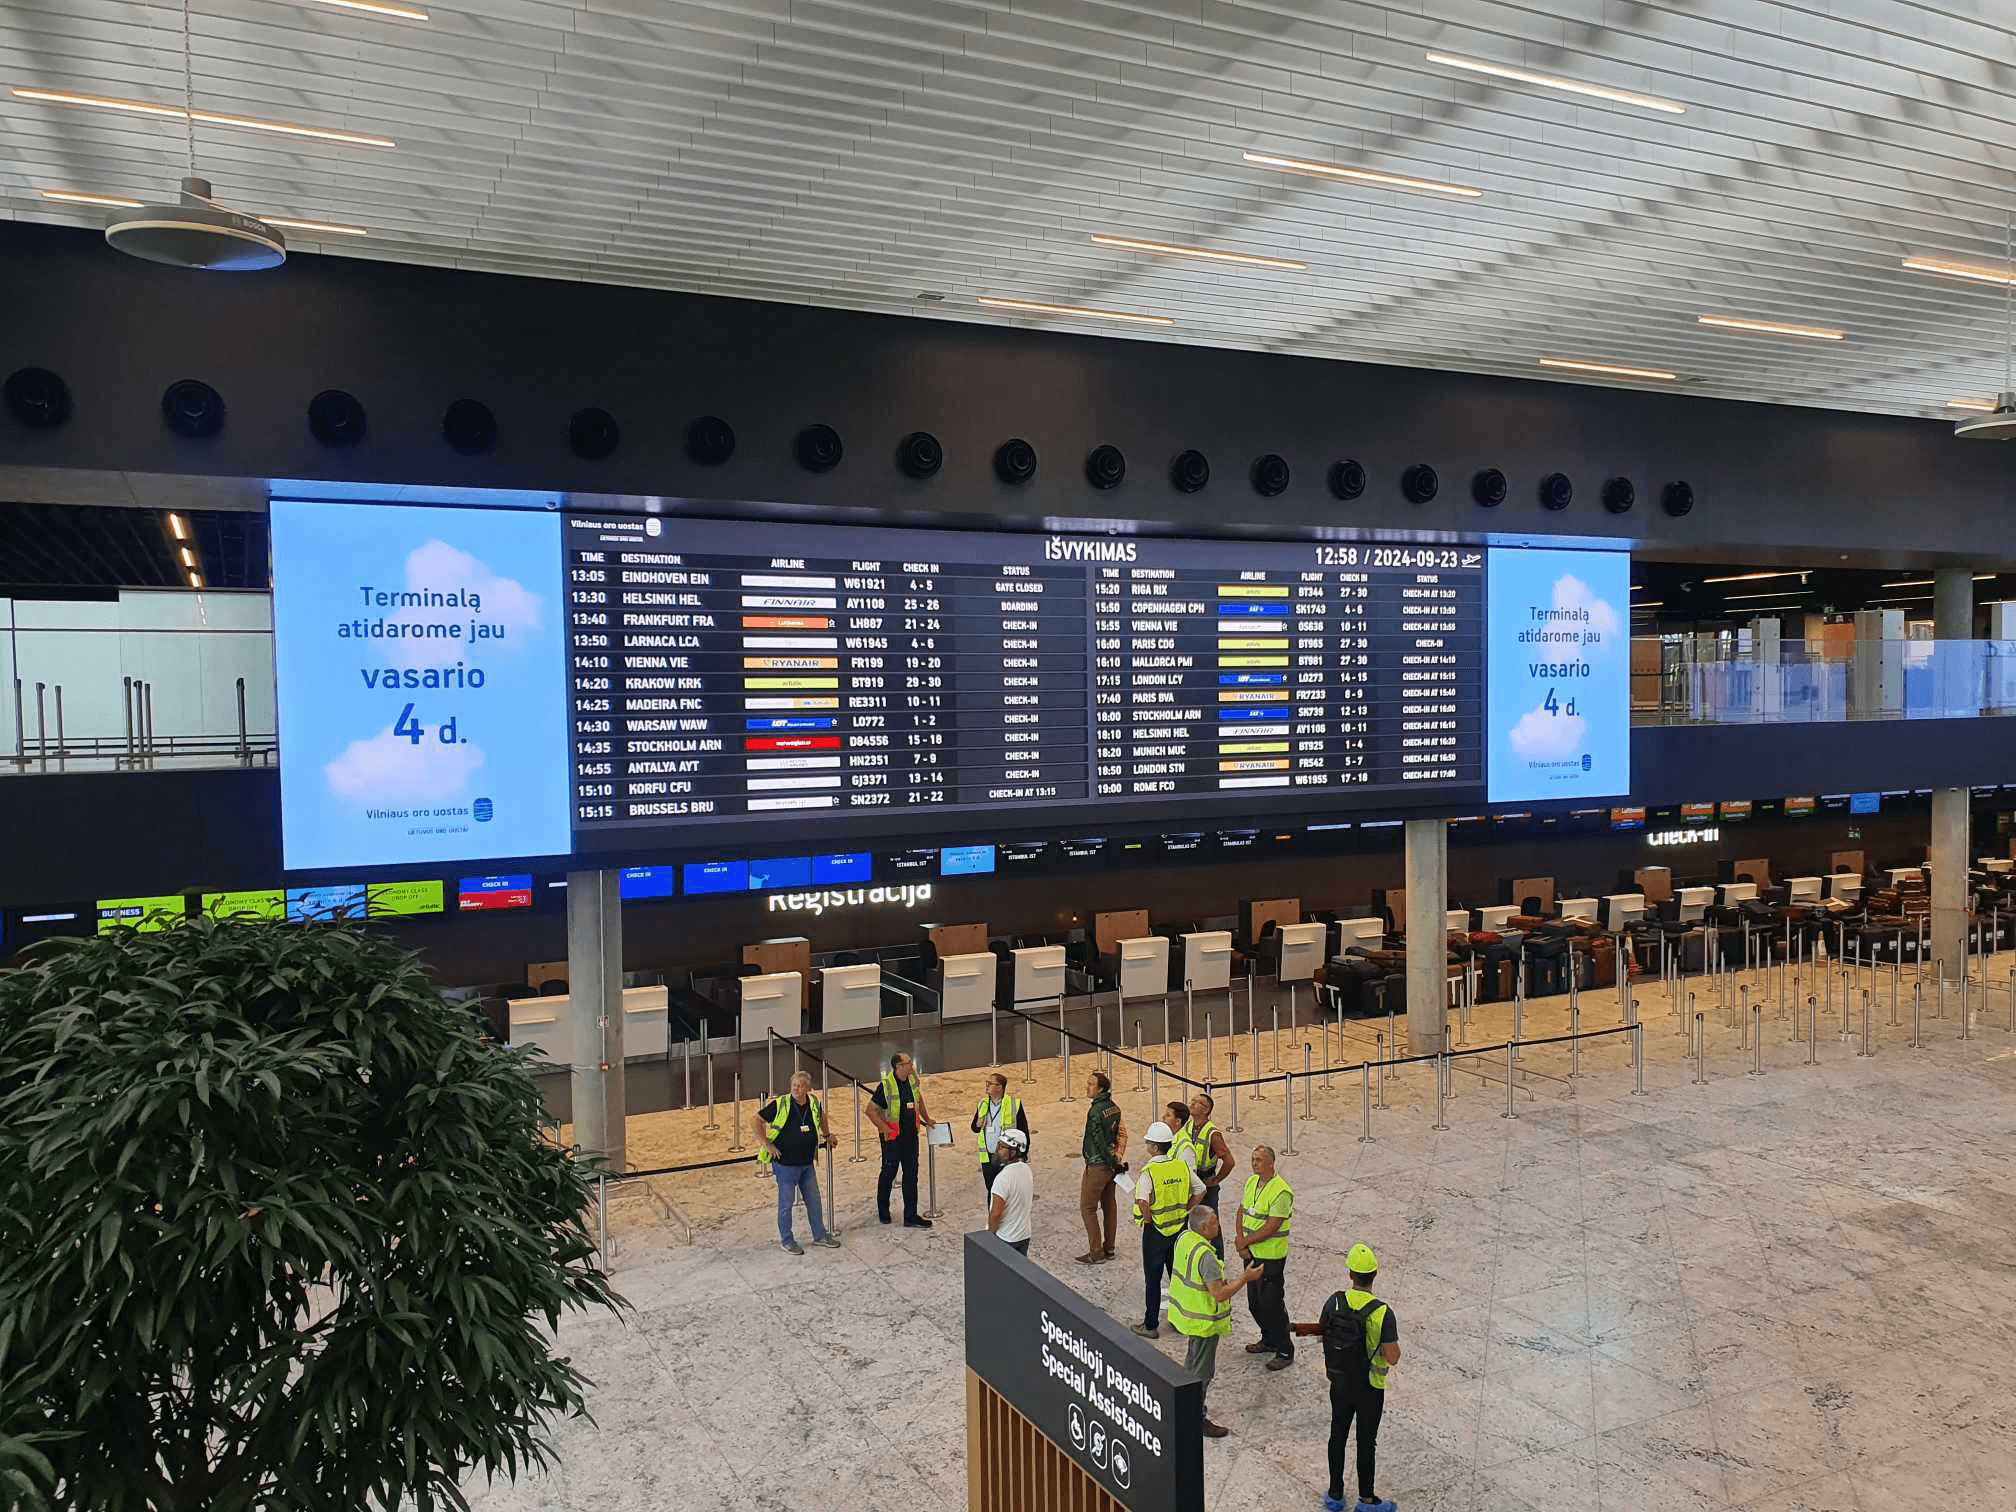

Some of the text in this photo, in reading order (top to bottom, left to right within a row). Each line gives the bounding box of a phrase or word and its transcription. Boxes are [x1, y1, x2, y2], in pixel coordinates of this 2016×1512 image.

[570, 519, 644, 531] Vilniaus oro uostas
[1045, 536, 1137, 562] IŠVYKIMAS
[1315, 546, 1458, 568] 12:58 / 2024-09-23
[580, 552, 1031, 576] TIME DESTINATION AIRLINE FLIGHT CHECK IN STATUS
[571, 569, 1044, 593] 13:05 EINDHOVEN EIN W61921 GATE CLOSED
[1102, 568, 1120, 578] TIME
[1131, 569, 1175, 579] DESTINATION
[1240, 571, 1267, 581] AIRLINE
[1095, 583, 1168, 596] 15:20 RIGA RIX
[360, 586, 482, 613] Terminalą
[572, 591, 1039, 612] 13:30 HELSINKI HEL FINNAIR AY1108 BOARDING
[1095, 601, 1205, 614] 15:50 COPENHAGEN CPH
[572, 613, 607, 625] 13:40
[623, 613, 690, 626] FRANKFURT
[692, 615, 715, 627] FRA
[1002, 620, 1038, 631] CHECK-IN
[1530, 606, 1590, 625] Terminalą
[338, 618, 505, 644] atidarome jau
[1095, 620, 1178, 632] 15:55 VIENNA VIE
[573, 634, 1038, 649] 13:50 LARNACA LCA W61945 CHECK-IN
[1131, 638, 1157, 650] PARIS
[1518, 627, 1601, 646] atidarome jau
[574, 656, 1038, 669] 14:10 VIENNA VIE RYANAIR FR199 CHECK-IN
[1132, 656, 1176, 667] MALLORCA
[1177, 656, 1193, 667] PMI
[1529, 657, 1591, 678] vasario
[361, 661, 486, 689] vasario
[575, 676, 1039, 690] 14:20 KRAKOW KRK BT919 CHECK-IN
[1096, 674, 1184, 686] 17:15 LONDON LCY
[575, 699, 610, 711] 14:25
[626, 698, 678, 711] MADEIRA
[679, 698, 702, 710] FNC
[848, 696, 887, 708] RE3311
[1003, 695, 1039, 705] CHECK-IN
[1096, 693, 1121, 704] 17:40
[1132, 692, 1157, 703] PARIS
[1158, 692, 1175, 703] BVA
[1544, 687, 1581, 717] 4 d.
[393, 702, 467, 745] 4 d.
[576, 720, 610, 733] 14:30
[626, 719, 678, 732] WARSAW
[679, 719, 708, 731] WAW
[1004, 714, 1039, 724] CHECK-IN
[1096, 709, 1202, 722] 18:00 STOCKHOLM ARN
[1096, 729, 1122, 740] 18:10
[1132, 727, 1172, 739] HELSINKI
[1173, 727, 1190, 738] HEL
[577, 742, 611, 754] 14:35
[627, 739, 697, 753] STOCKHOLM
[698, 739, 722, 751] ARN
[1004, 732, 1039, 742] CHECK-IN
[1097, 745, 1186, 758] 18:20 MUNICH MUC
[578, 751, 1040, 775] 14:55 ANTALYA AYT HN2351 CHECK-IN
[1097, 765, 1122, 776] 18:50
[1133, 763, 1168, 775] LONDON
[1168, 762, 1185, 773] STN
[578, 769, 1040, 797] 15:10 KORFU CFU GJ3371 CHECK-IN
[1097, 780, 1175, 794] 19:00 ROME FCO
[579, 787, 1056, 818] 15:15 BRUSSELS BRU SN2372 CHECK-IN AT 13:15
[366, 805, 469, 820] Vilniaus oro uostas
[101, 907, 141, 918] BUSNESS
[1041, 1310, 1162, 1422] Specialioji pagalba
[1041, 1344, 1162, 1457] Special Assistance
